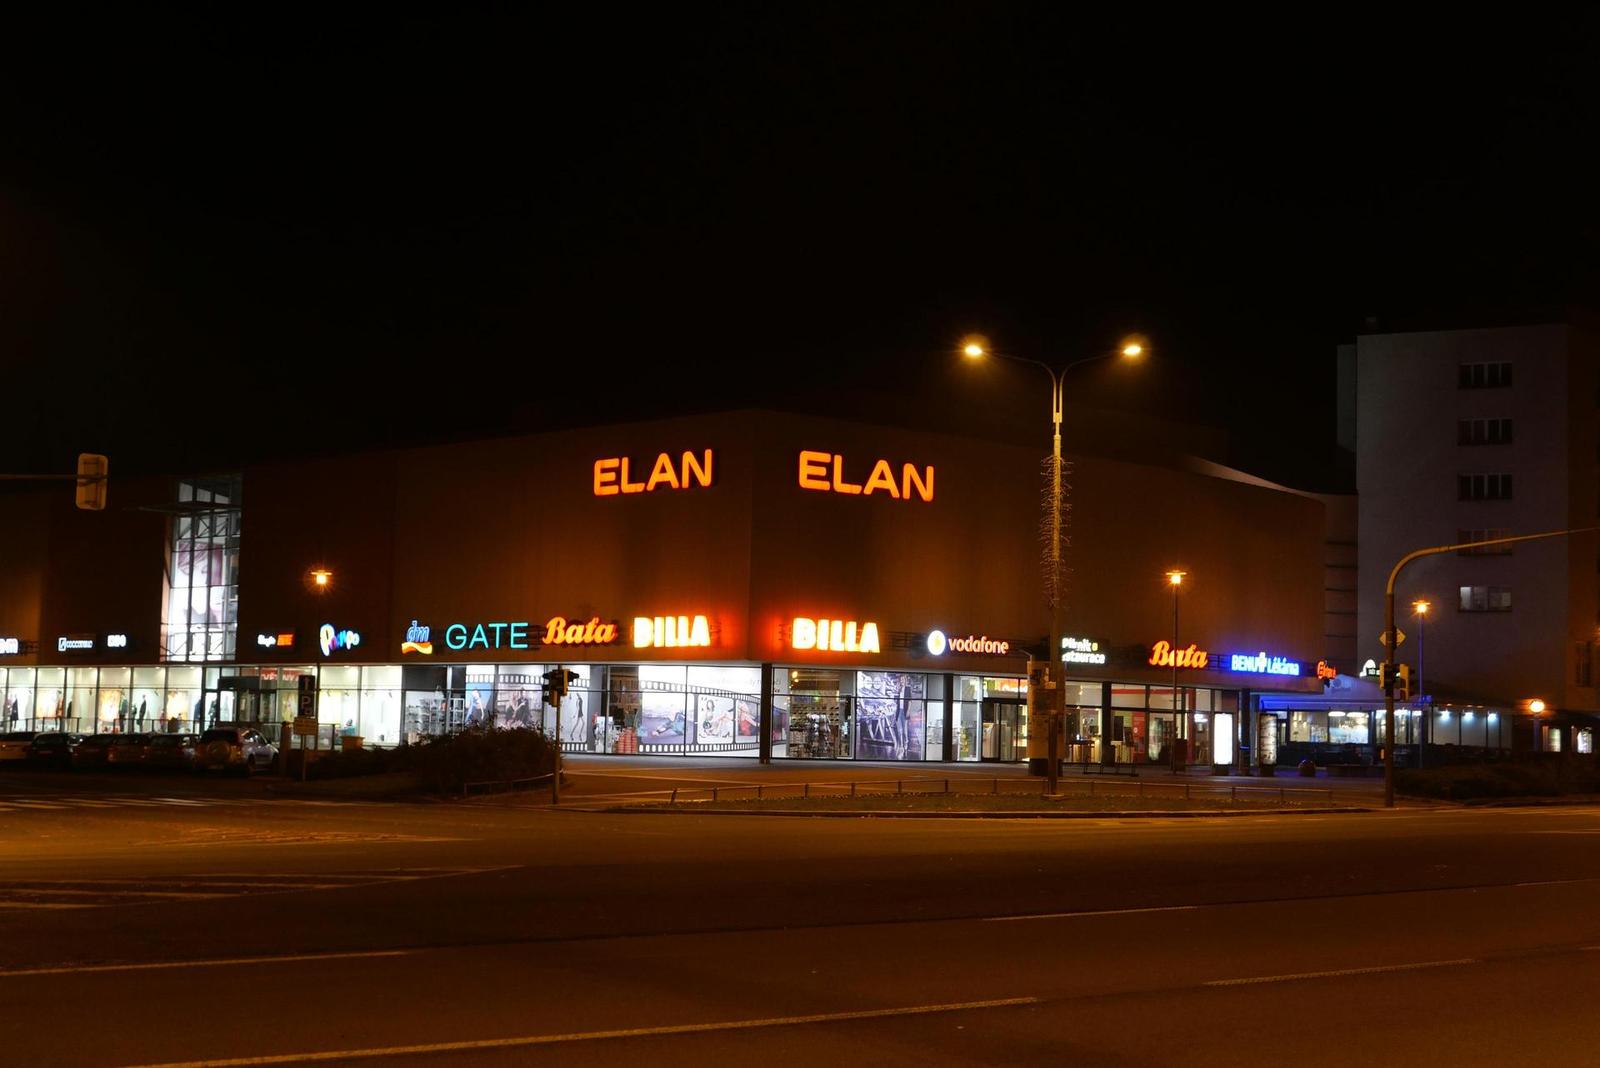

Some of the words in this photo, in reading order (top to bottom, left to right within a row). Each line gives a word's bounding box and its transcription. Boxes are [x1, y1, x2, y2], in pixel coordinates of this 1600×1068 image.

[593, 449, 712, 496] ELAN
[799, 450, 935, 502] ELAN
[406, 620, 430, 642] dm
[446, 622, 529, 650] GATE
[634, 615, 710, 648] BILLA
[792, 617, 881, 653] BILLA
[948, 635, 1009, 655] vodafone
